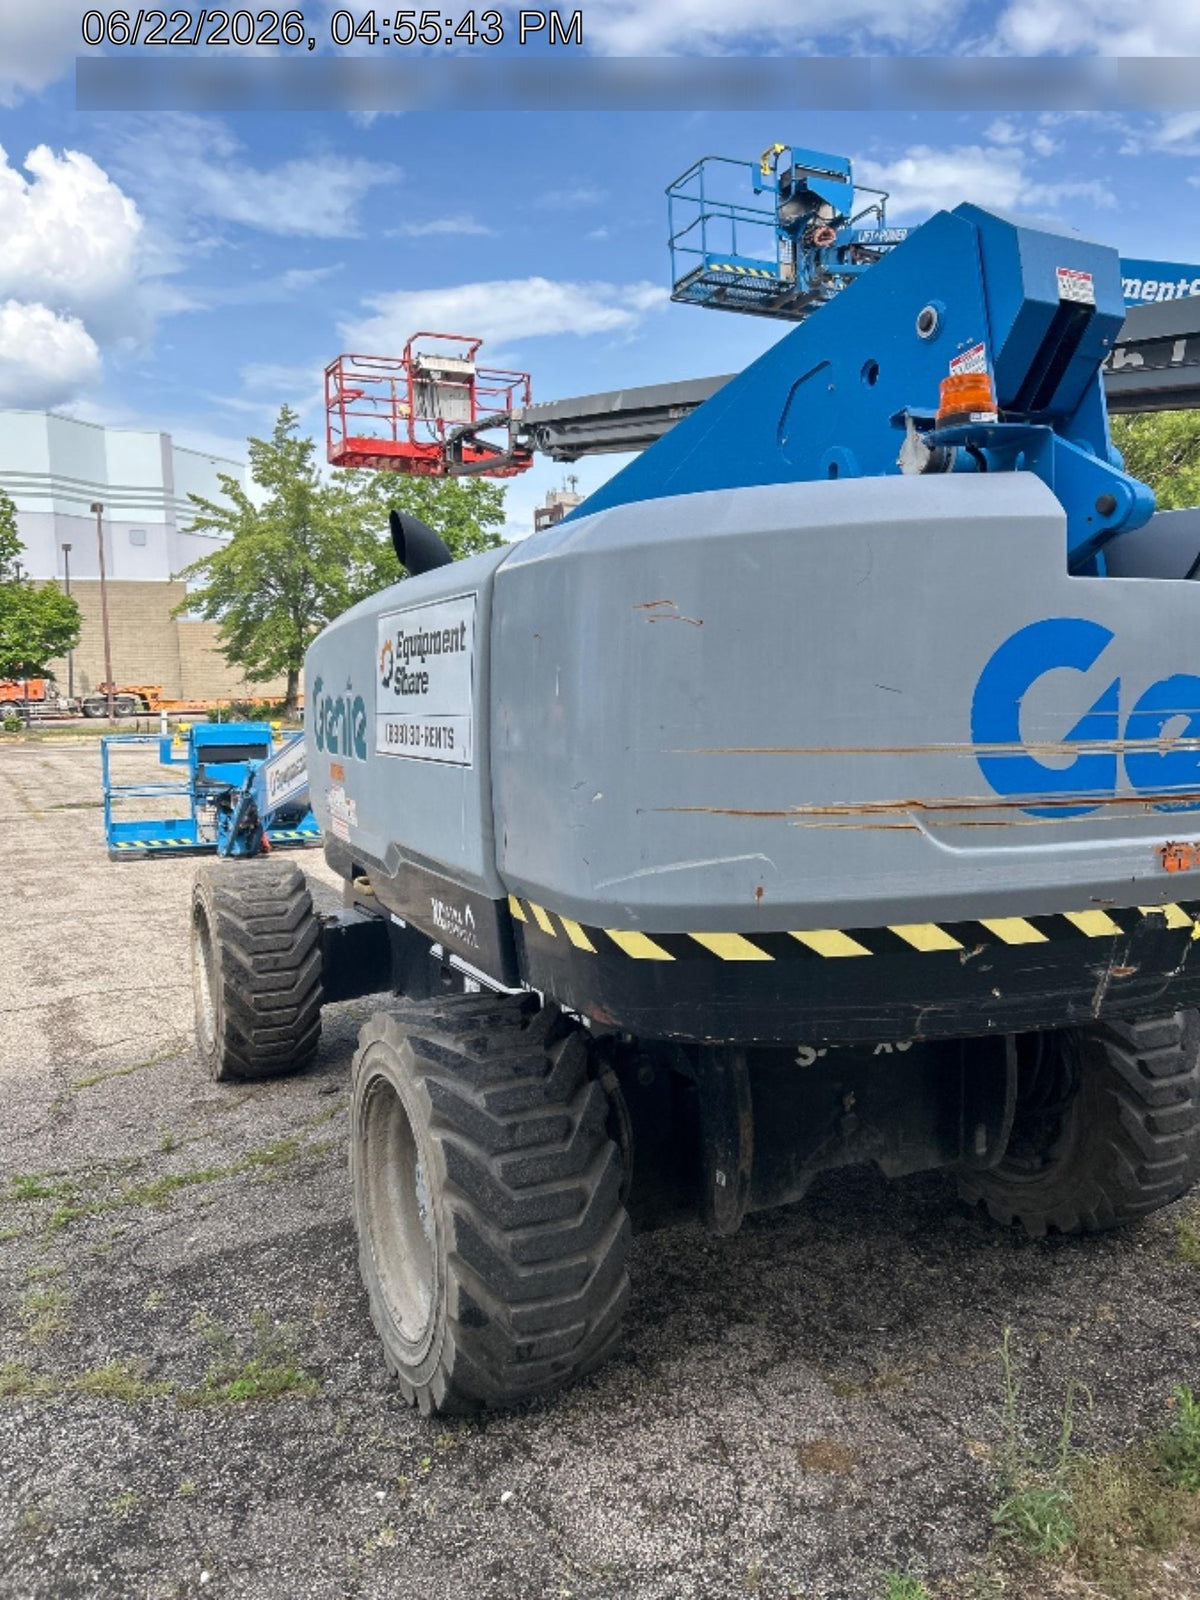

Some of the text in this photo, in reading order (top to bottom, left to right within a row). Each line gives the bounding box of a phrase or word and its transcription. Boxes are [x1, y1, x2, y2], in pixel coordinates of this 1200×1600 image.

[396, 620, 466, 665] Equipment
[394, 666, 429, 696] Share
[312, 675, 367, 762] Genie
